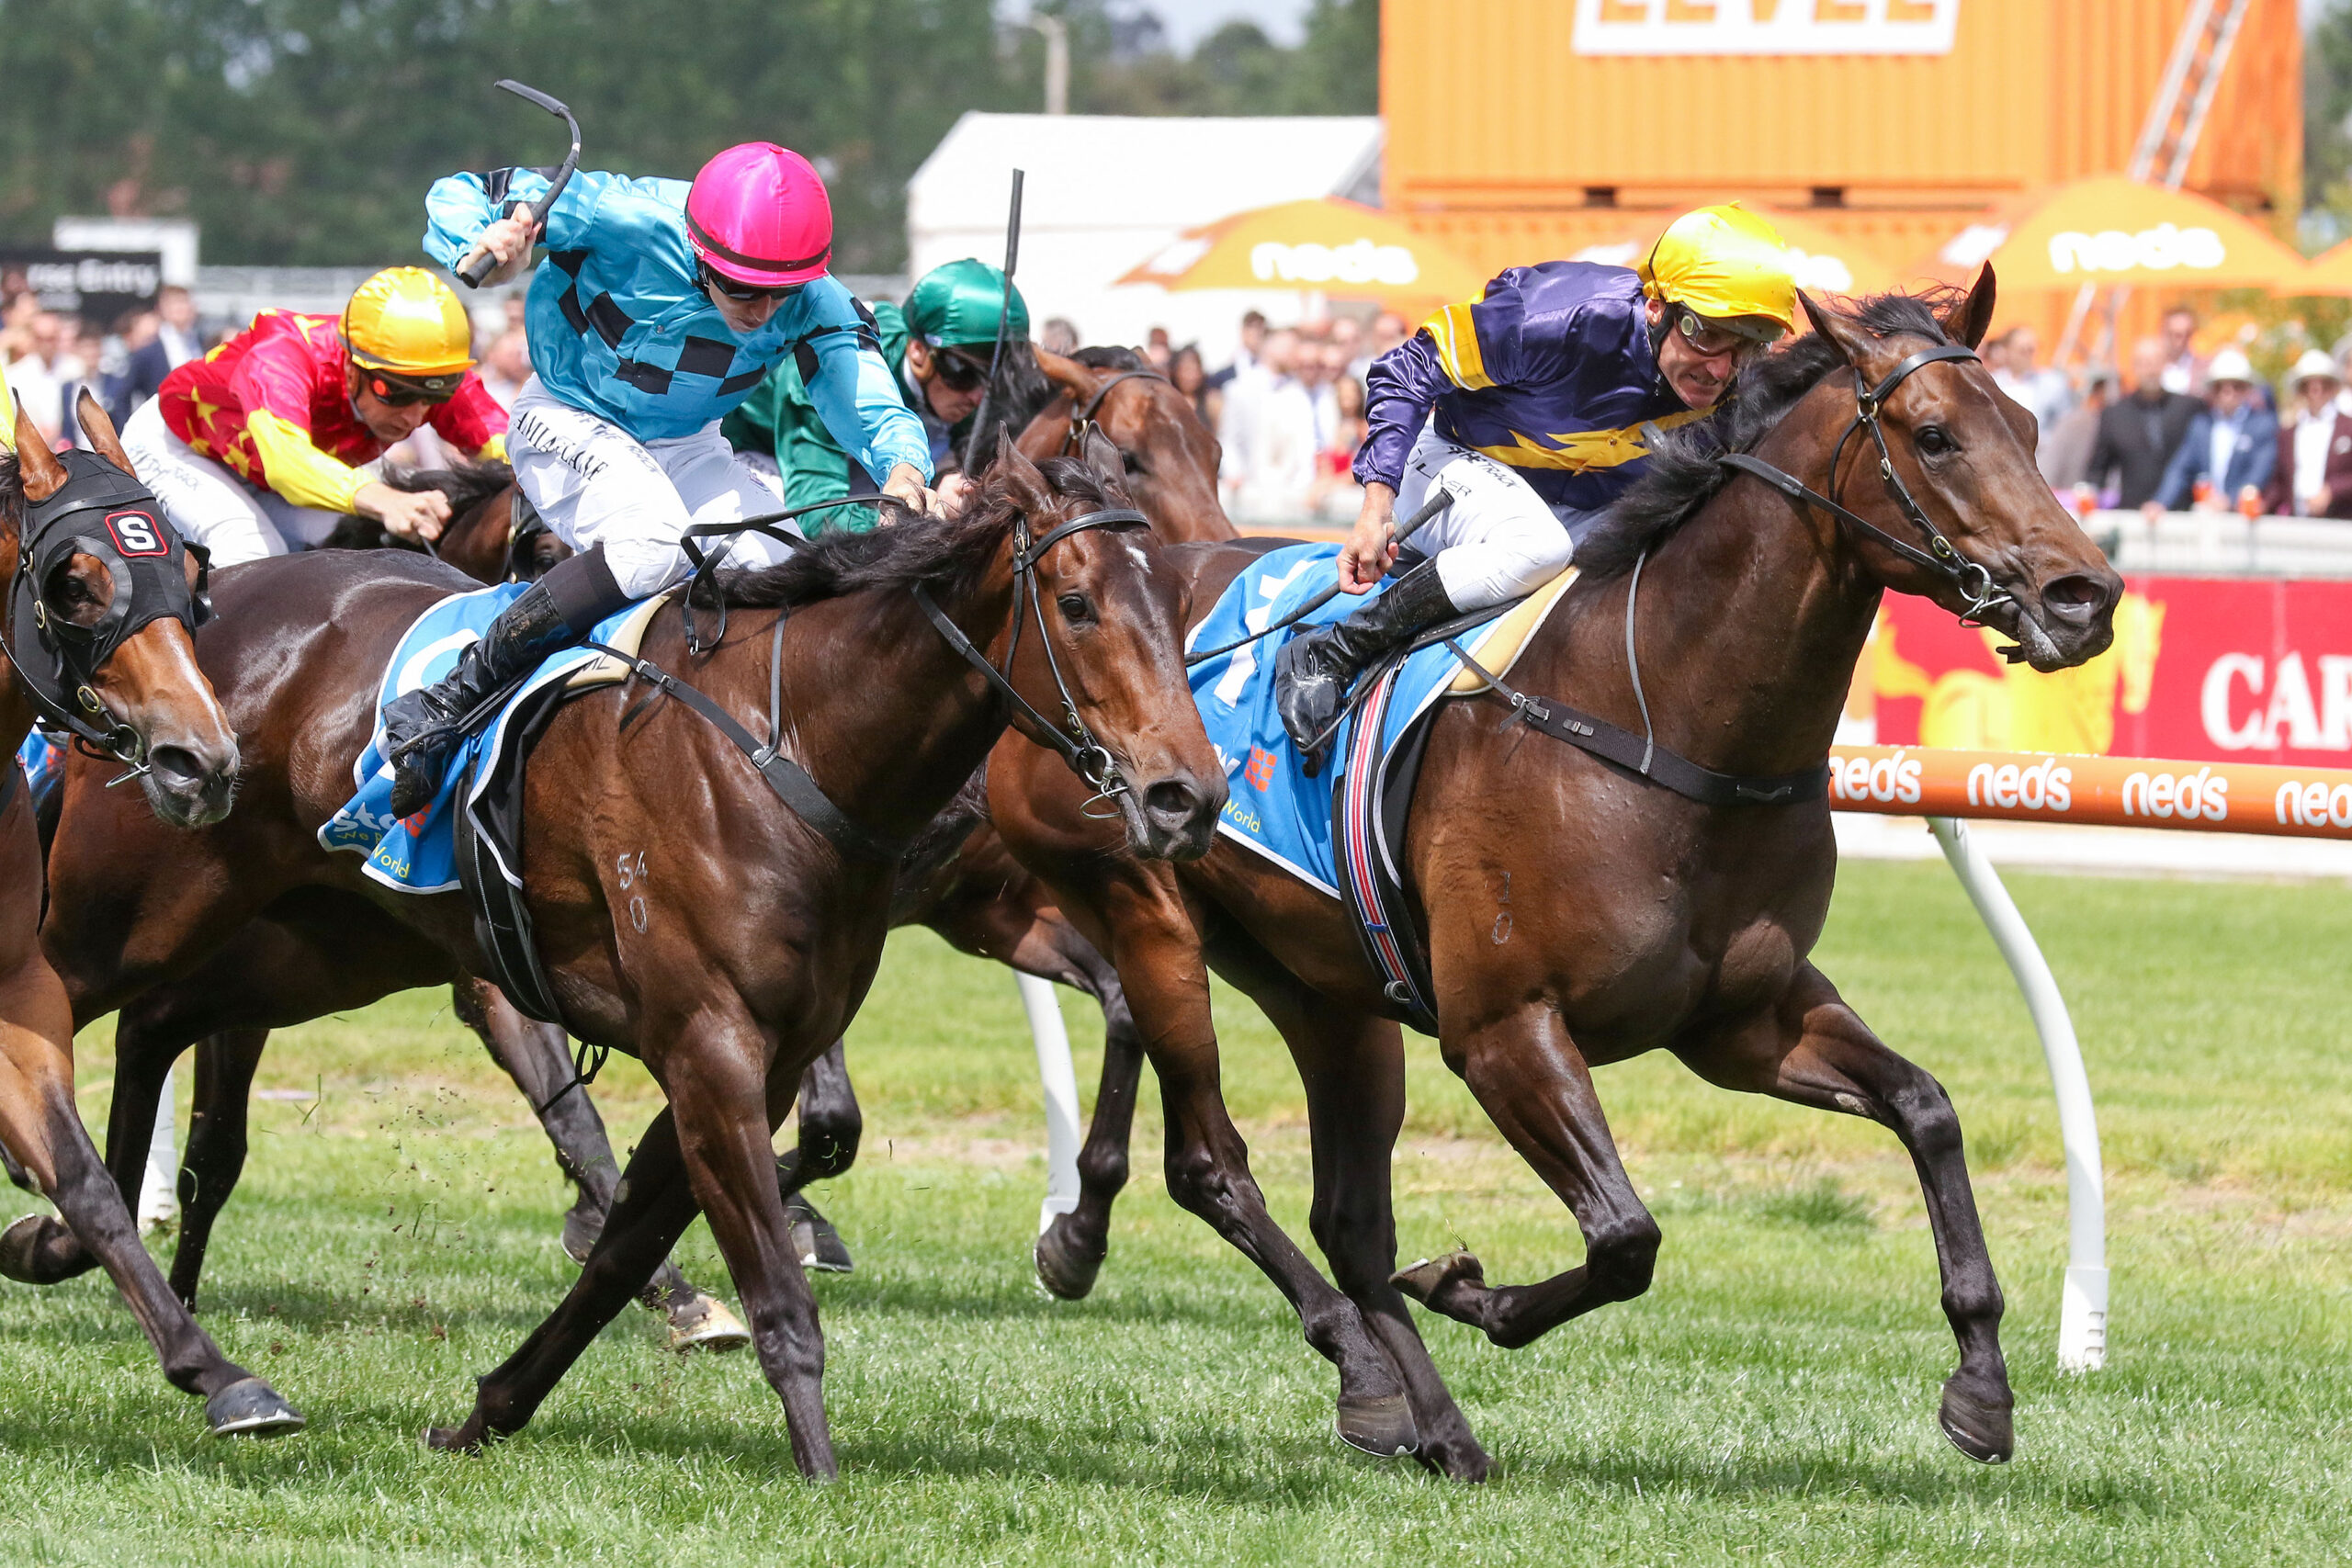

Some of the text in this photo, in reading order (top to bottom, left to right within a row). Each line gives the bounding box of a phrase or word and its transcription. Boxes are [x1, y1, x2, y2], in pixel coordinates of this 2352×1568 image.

[2048, 222, 2225, 273] neds
[118, 516, 156, 550] S
[1828, 750, 1921, 804] neds
[1968, 757, 2072, 811] neds
[2122, 767, 2228, 821] neds
